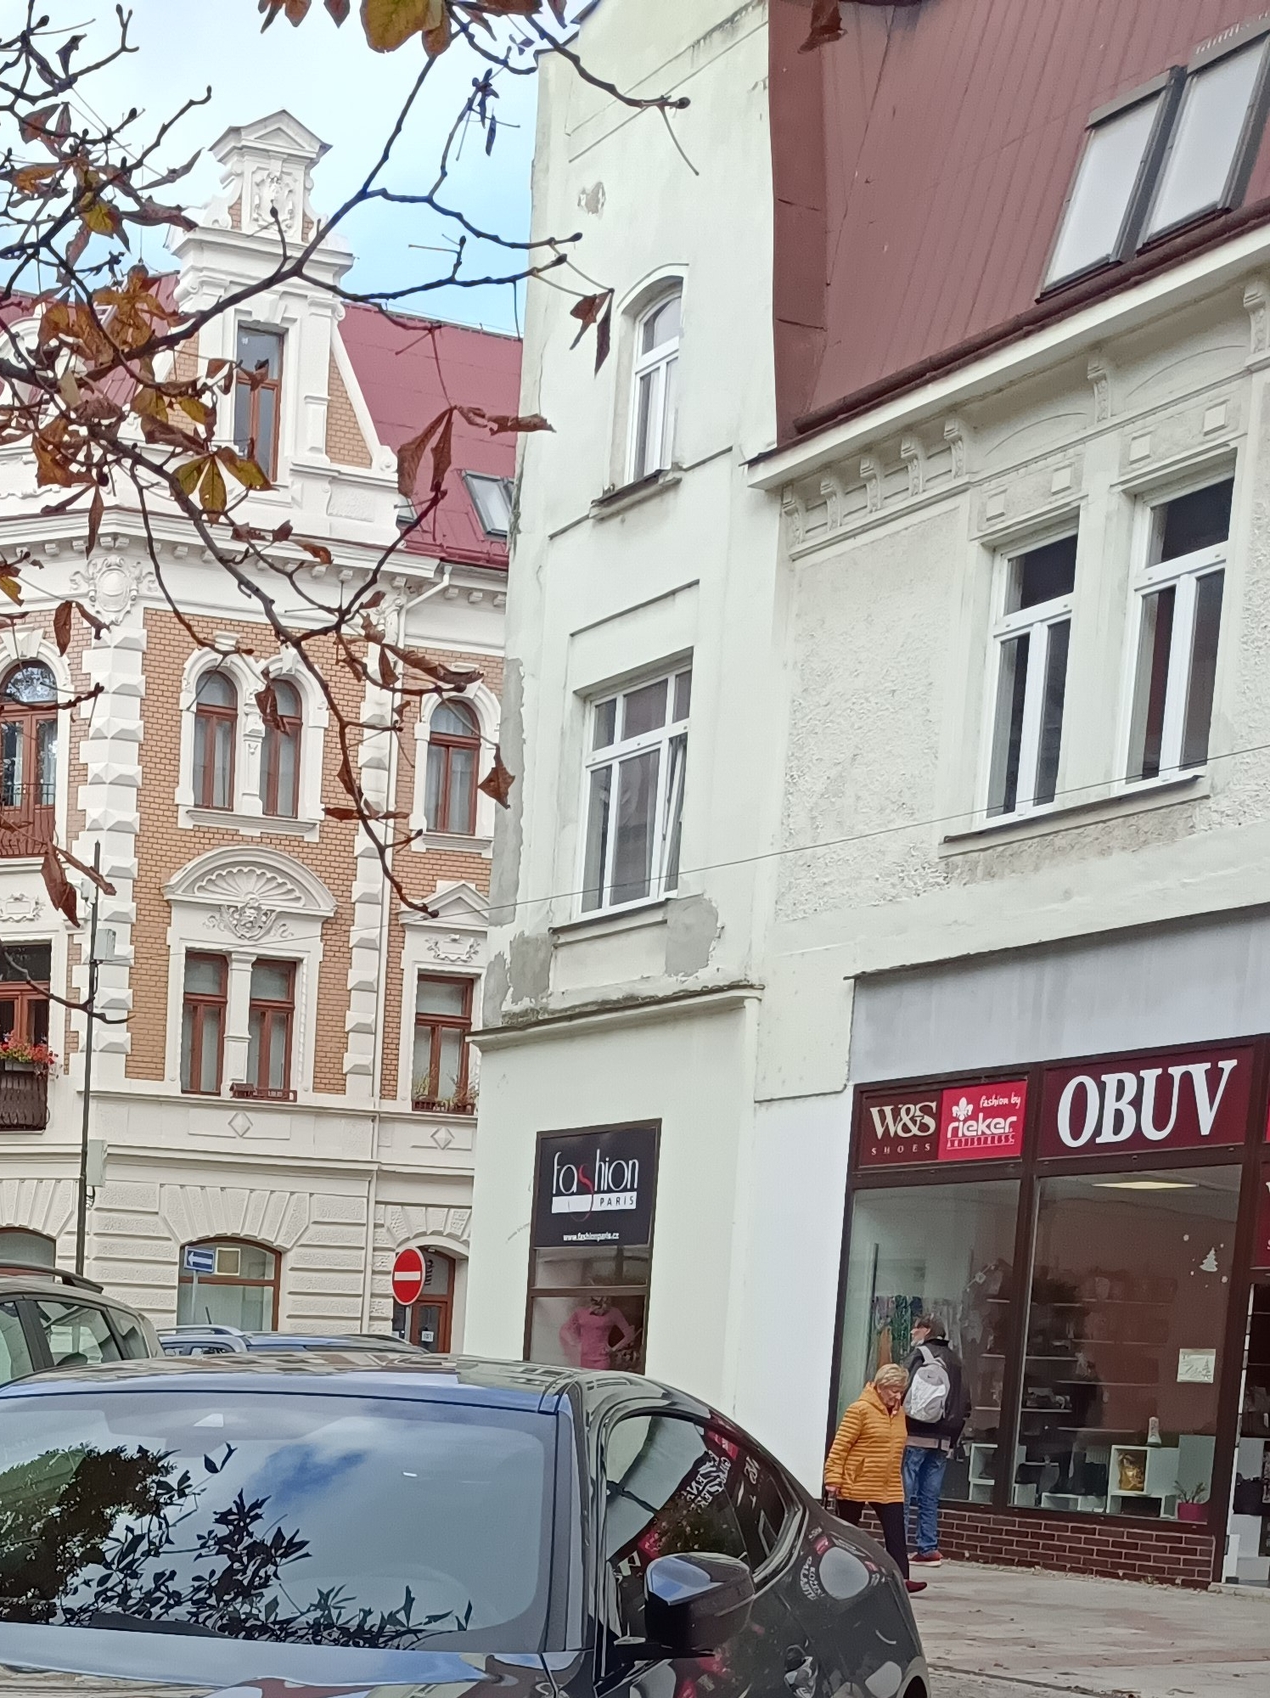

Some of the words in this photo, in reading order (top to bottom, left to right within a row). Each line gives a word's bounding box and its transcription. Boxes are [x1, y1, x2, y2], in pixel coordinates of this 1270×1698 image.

[980, 1094, 1009, 1108] fashion
[1011, 1092, 1022, 1109] by
[1057, 1059, 1238, 1148] OBUV
[869, 1101, 937, 1140] W&S
[947, 1113, 1017, 1138] rieker
[871, 1143, 931, 1156] SHOES
[552, 1148, 639, 1195] fashion
[599, 1196, 634, 1207] PARIS
[563, 1232, 620, 1242] www.fashionparis.cz
